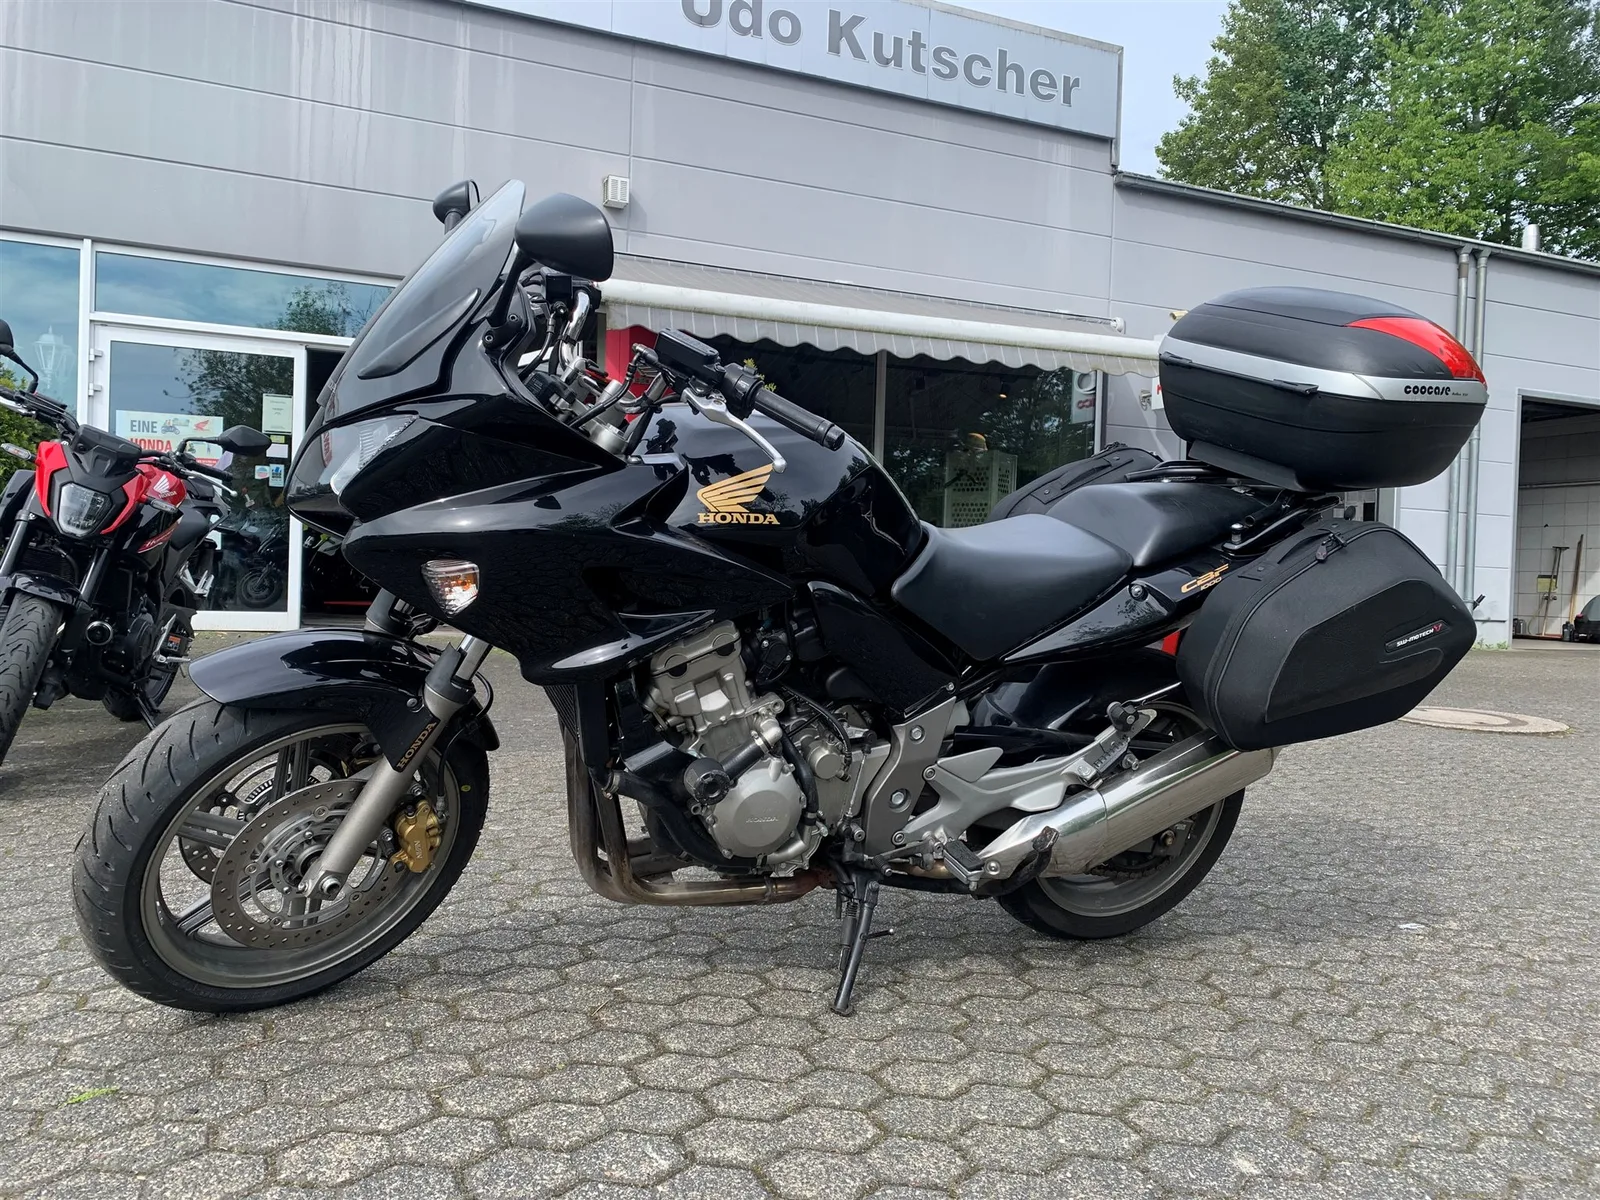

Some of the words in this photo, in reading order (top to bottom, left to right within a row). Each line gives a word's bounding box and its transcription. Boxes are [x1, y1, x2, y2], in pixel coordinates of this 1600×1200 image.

[681, 0, 803, 46] Udo
[827, 8, 1081, 107] Kutscher
[130, 419, 158, 434] EINE
[697, 512, 781, 525] HONDA
[1181, 563, 1229, 593] CBF
[396, 721, 437, 770] HONDA
